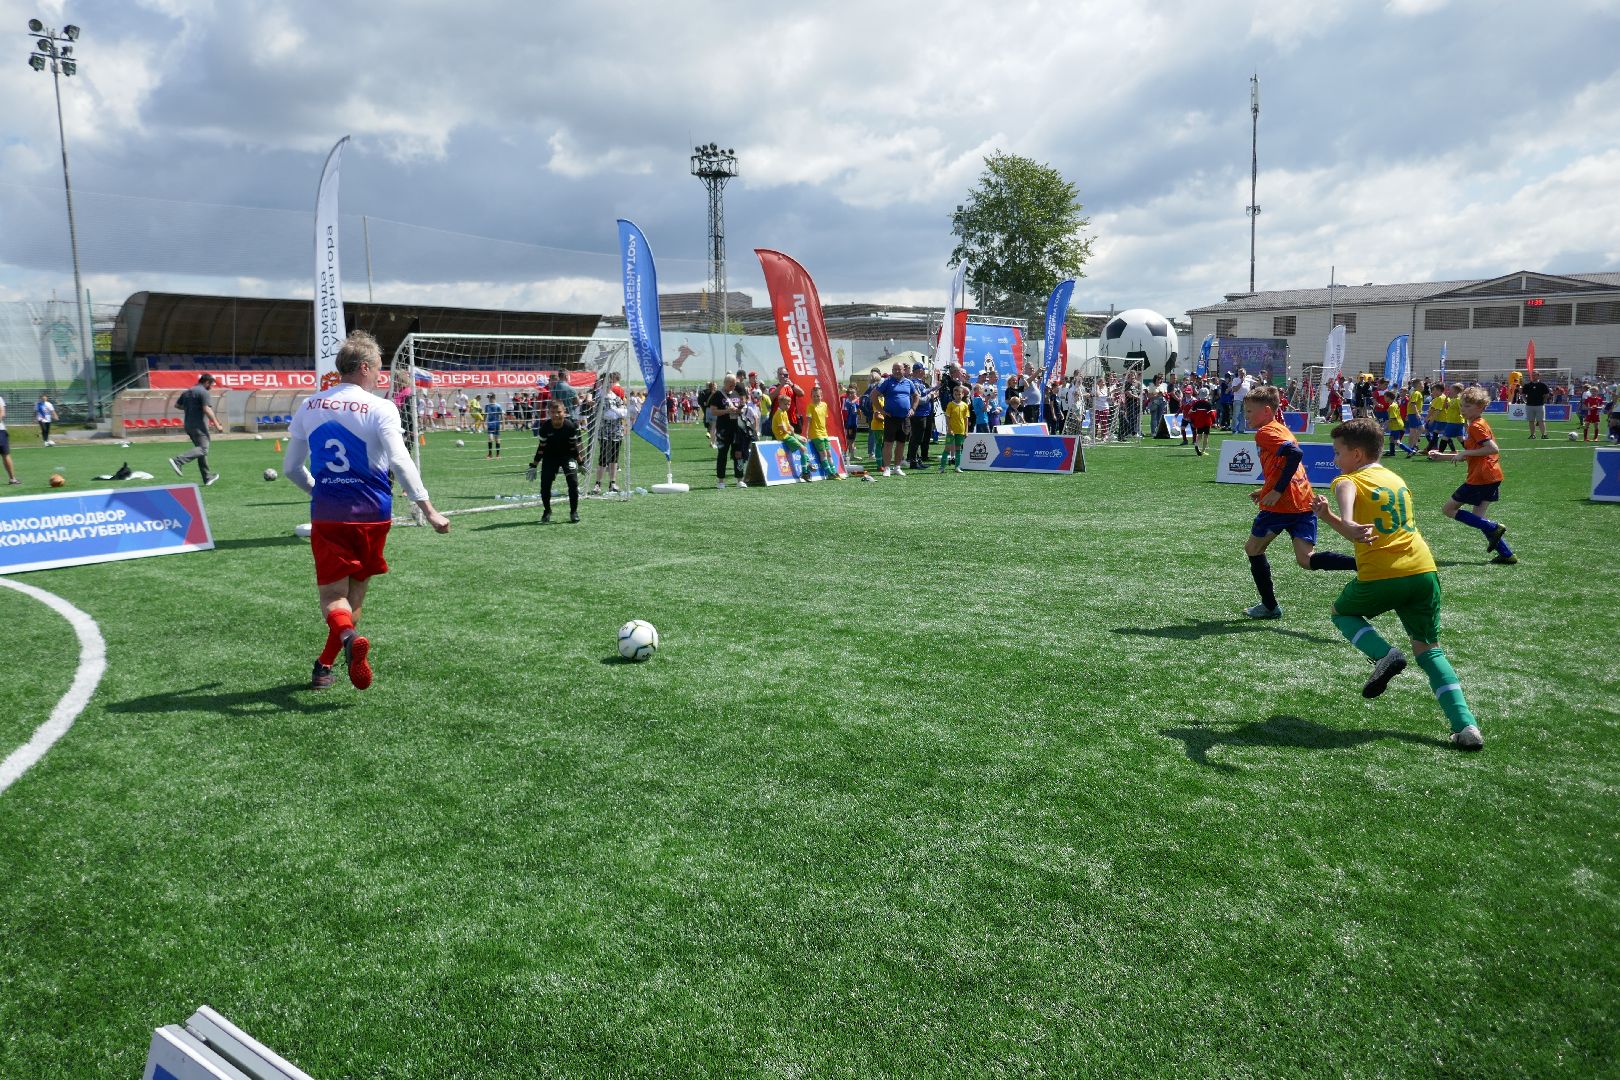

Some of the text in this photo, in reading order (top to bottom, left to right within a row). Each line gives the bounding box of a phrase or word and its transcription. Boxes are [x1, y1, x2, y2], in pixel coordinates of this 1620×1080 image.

[321, 271, 329, 359] Команда
[198, 373, 283, 387] ПЕРЕД,
[432, 373, 494, 385] ВПЕРЕД,
[307, 399, 369, 414] ХЛЕСТОВ
[324, 438, 351, 473] 3
[1371, 486, 1416, 534] 30
